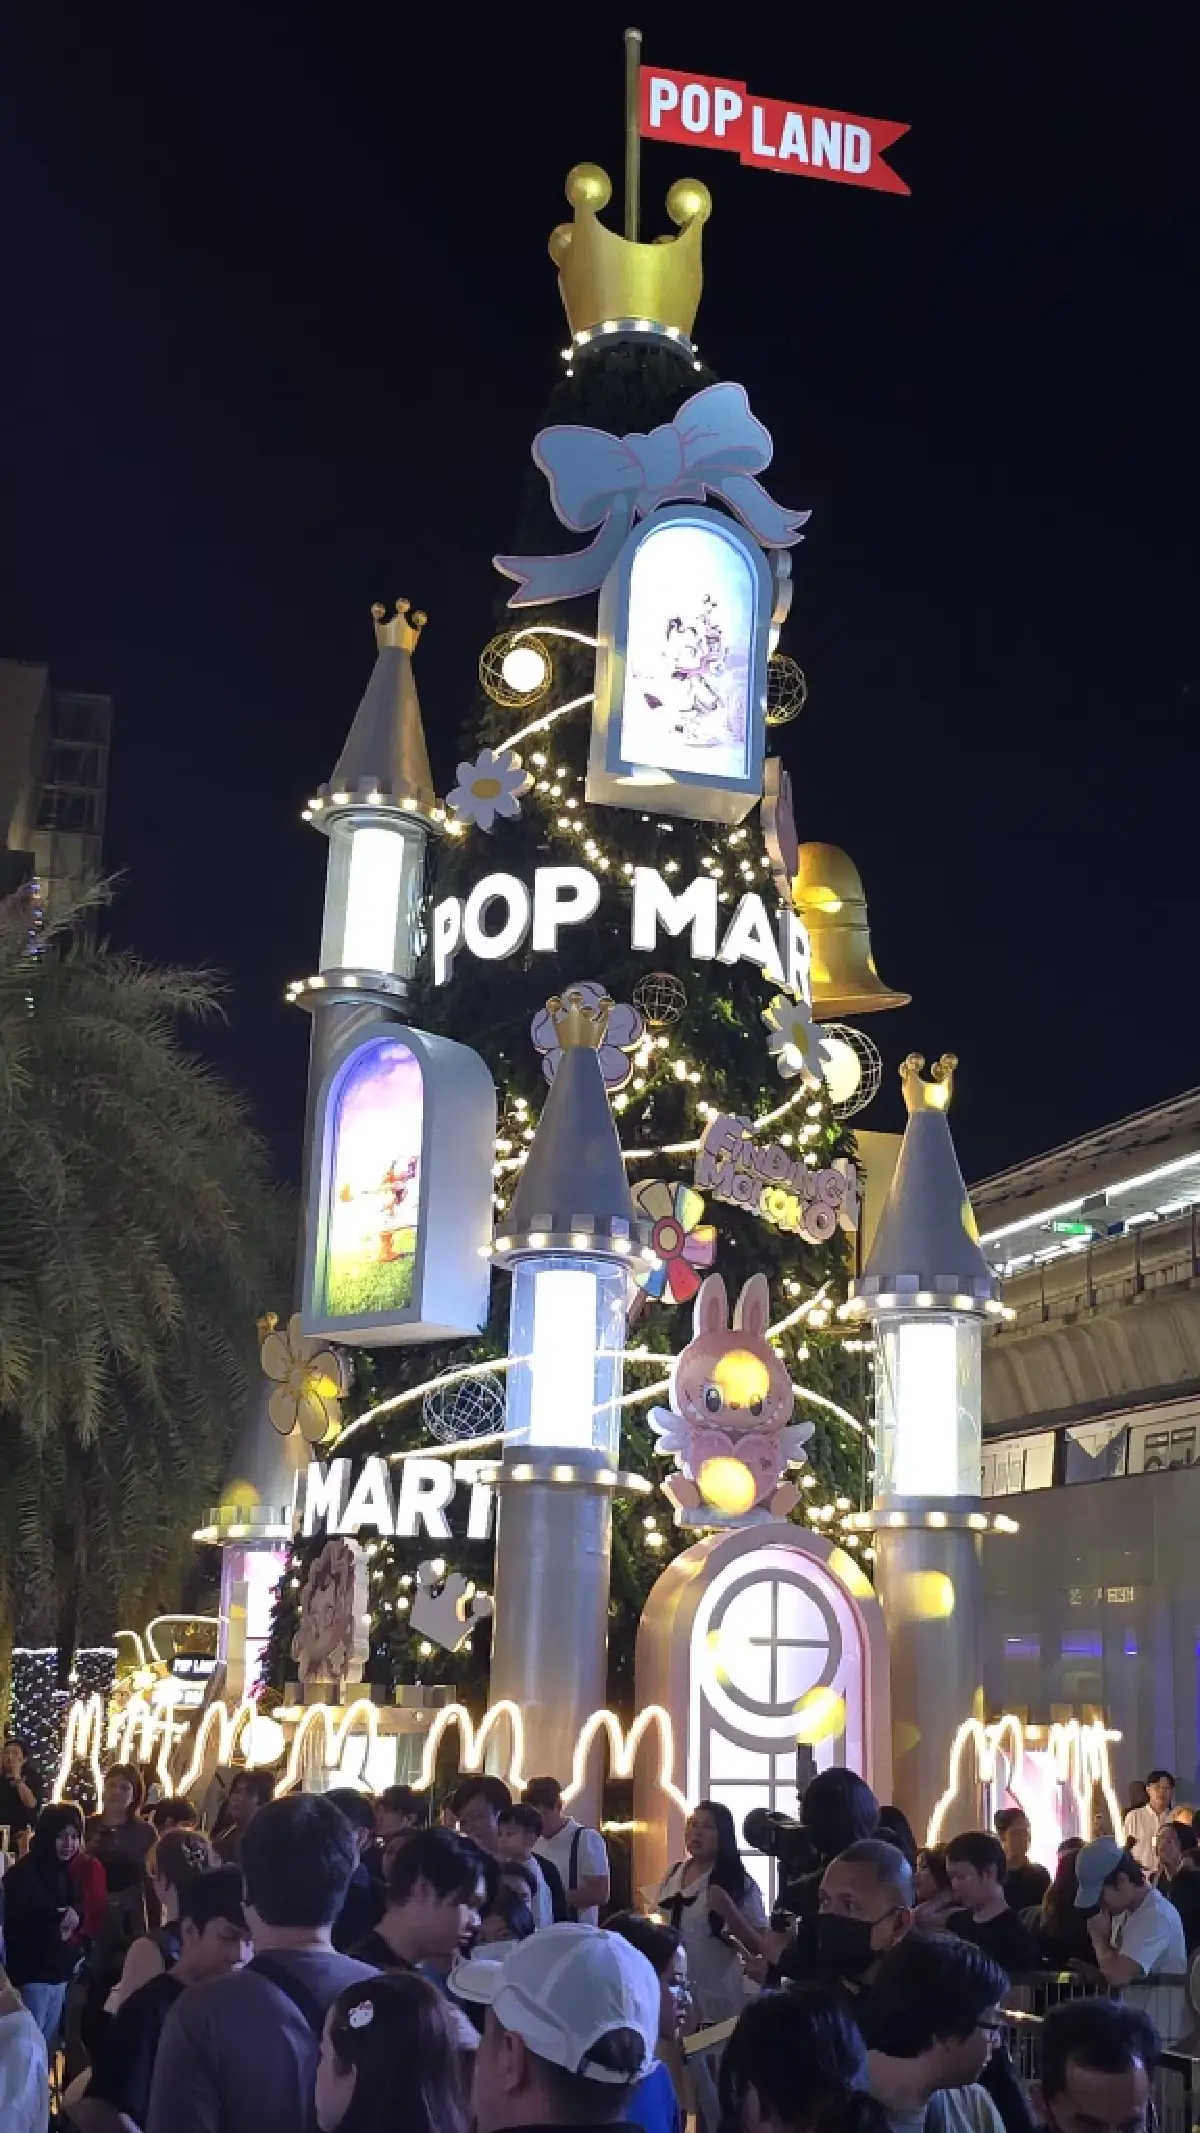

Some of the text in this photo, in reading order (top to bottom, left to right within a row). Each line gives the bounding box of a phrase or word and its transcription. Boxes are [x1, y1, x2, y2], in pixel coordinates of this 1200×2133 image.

[649, 76, 872, 174] POP LAND
[432, 865, 812, 1008] POP MAR
[301, 1455, 503, 1540] MART
